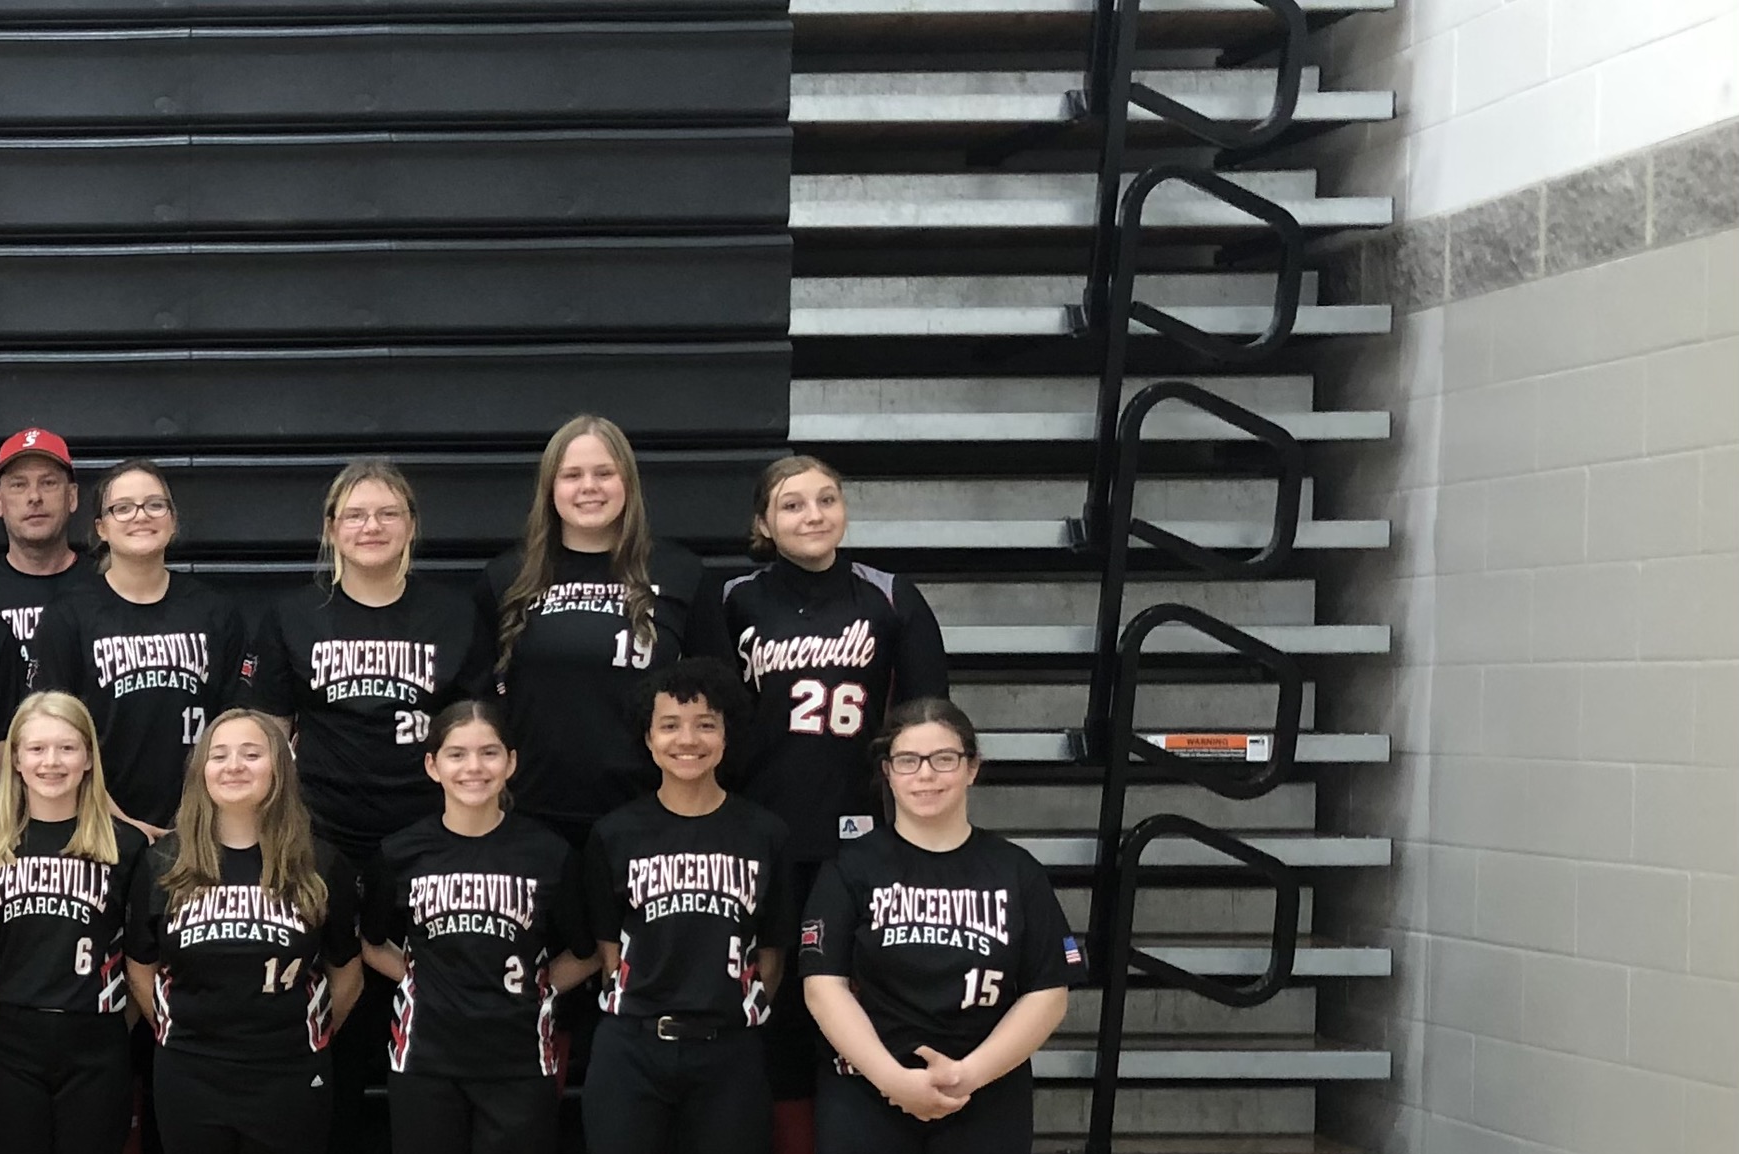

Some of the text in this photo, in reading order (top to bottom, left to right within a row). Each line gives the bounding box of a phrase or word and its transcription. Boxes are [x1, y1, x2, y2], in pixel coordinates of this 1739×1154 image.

[93, 633, 209, 685] SPENCERVILLE
[310, 639, 434, 693] SPENCERVILLE
[612, 631, 653, 669] 19
[738, 618, 874, 683] Spencerville
[114, 670, 198, 698] BEARCATS
[327, 679, 417, 705] BEARCATS
[182, 707, 205, 744] 17
[790, 679, 865, 736] 26
[395, 710, 430, 744] 20
[1187, 738, 1229, 746] WARNING
[627, 852, 760, 913] SPENCERVILLE
[3, 900, 90, 924] BEARCATS
[410, 873, 537, 930] SPENCERVILLE
[645, 896, 743, 923] BEARCATS
[868, 884, 1007, 945] SPENCERVILLE
[180, 922, 290, 947] BEARCATS
[427, 914, 516, 942] BEARCATS
[883, 925, 991, 956] BEARCATS
[75, 938, 92, 975] 6
[503, 955, 524, 995] 2
[727, 936, 743, 979] 5
[261, 958, 302, 993] 14
[962, 968, 1002, 1008] 15
